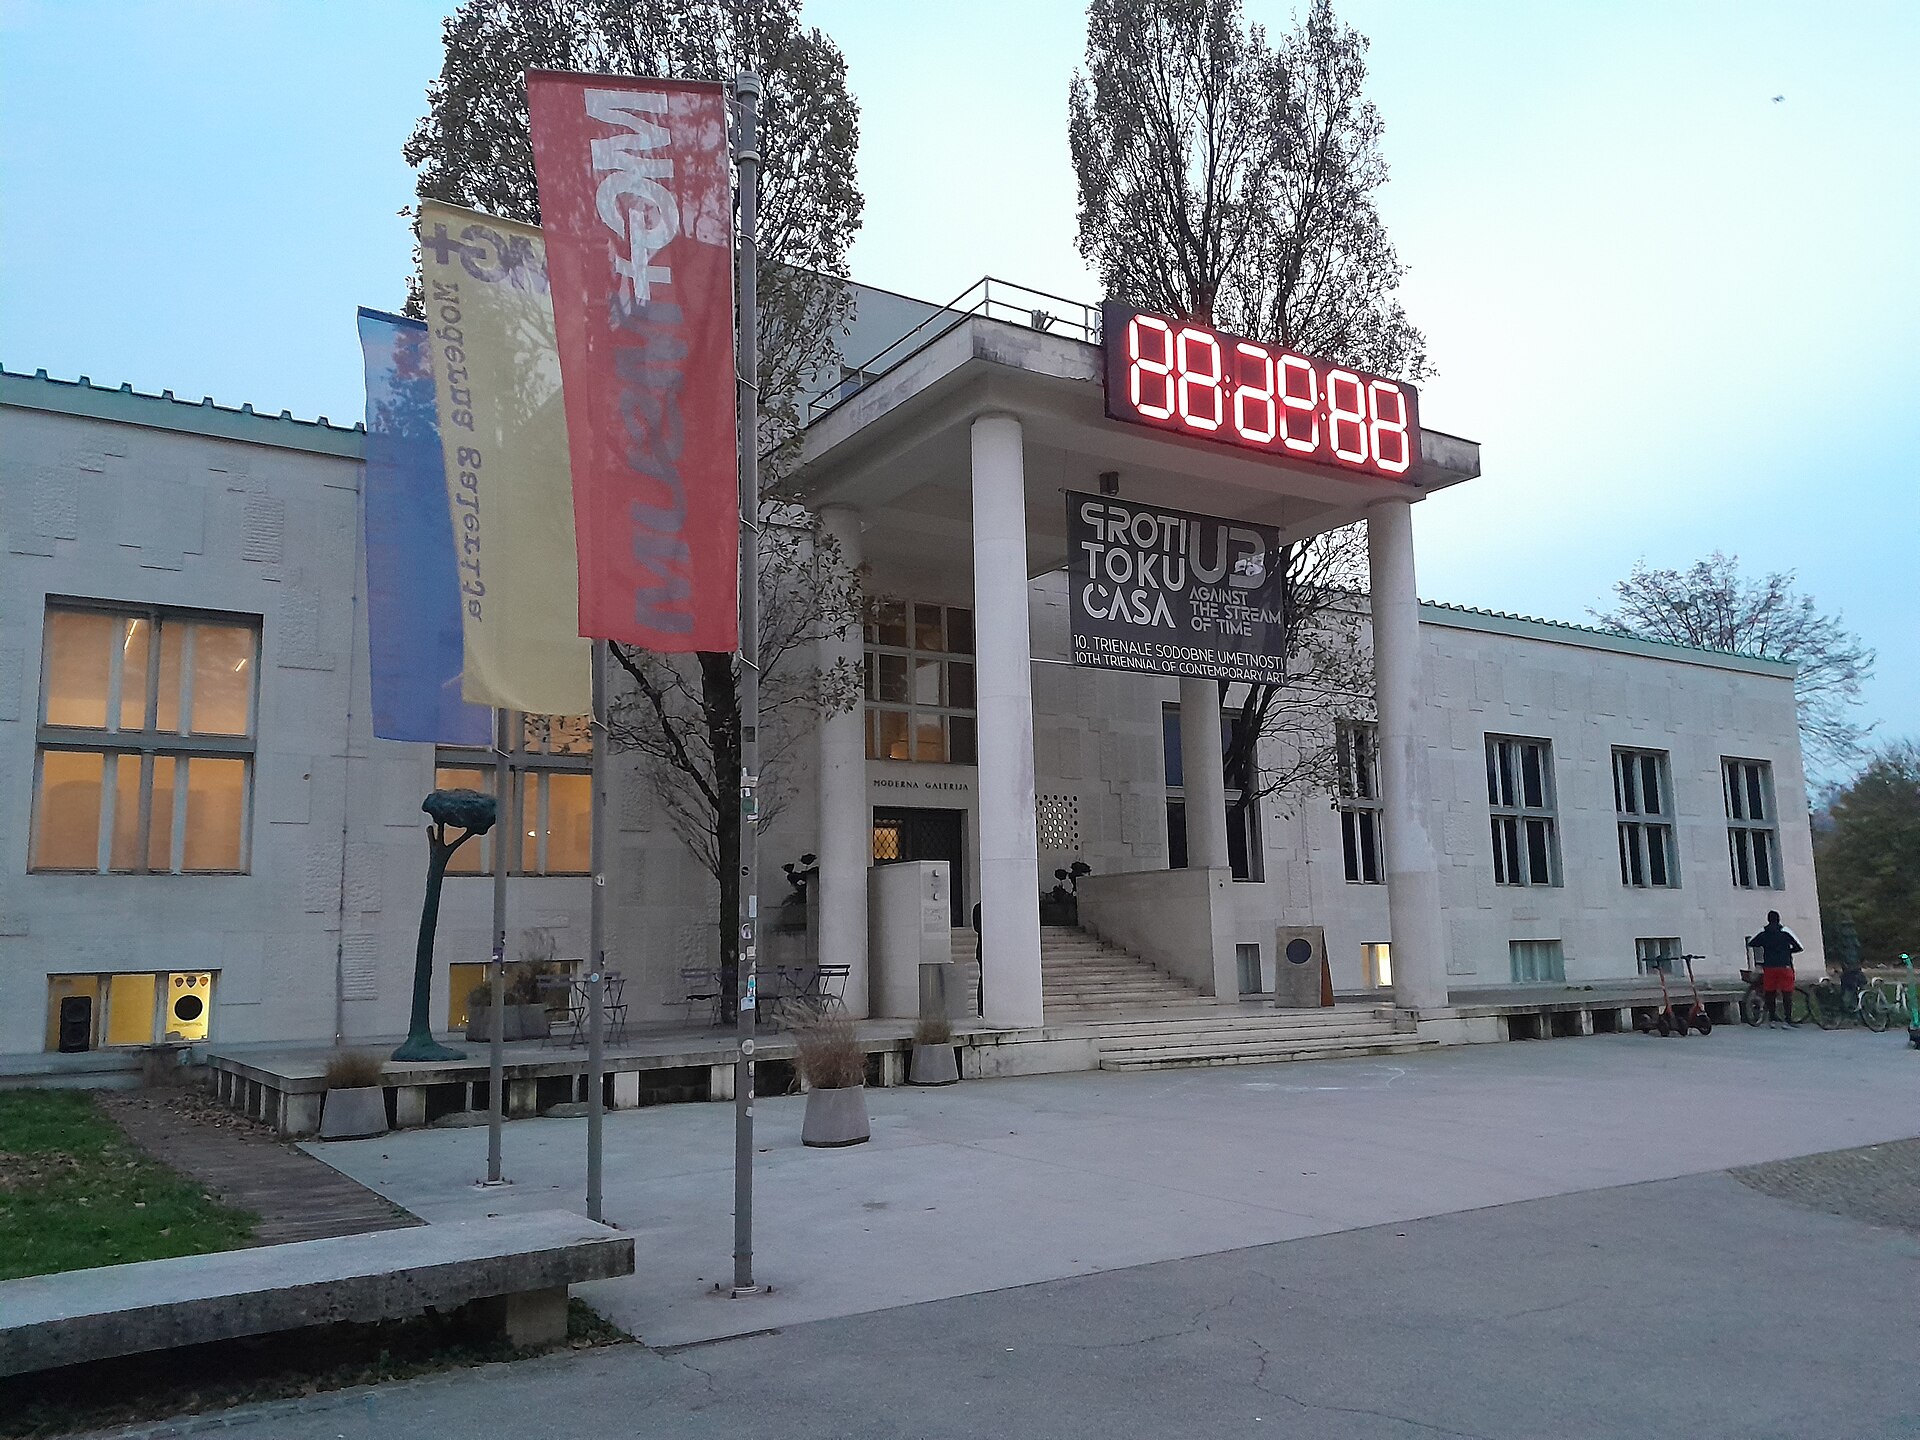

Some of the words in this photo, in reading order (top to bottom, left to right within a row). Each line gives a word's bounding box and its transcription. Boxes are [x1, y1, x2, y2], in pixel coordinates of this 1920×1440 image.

[1080, 501, 1187, 555] PROTI
[1081, 540, 1186, 592] TOKU
[1189, 585, 1249, 606] AGAINST
[1189, 600, 1219, 619] THE
[1224, 604, 1282, 625] STREAM
[1190, 616, 1212, 633] OF
[1216, 618, 1252, 637] TIME
[1073, 633, 1090, 650] 10.
[1092, 636, 1152, 657] TRIENALE
[1156, 644, 1214, 664] SODOBNE
[1217, 650, 1284, 670] UMETNOSTI
[1074, 651, 1101, 666] 10TH
[1103, 653, 1159, 671] TRIENNIAL
[1161, 660, 1177, 673] OF
[1179, 662, 1263, 682] CONTEMPORARY
[1266, 671, 1285, 684] ART
[873, 779, 919, 789] MODERNA
[925, 782, 968, 791] GALERIJA
